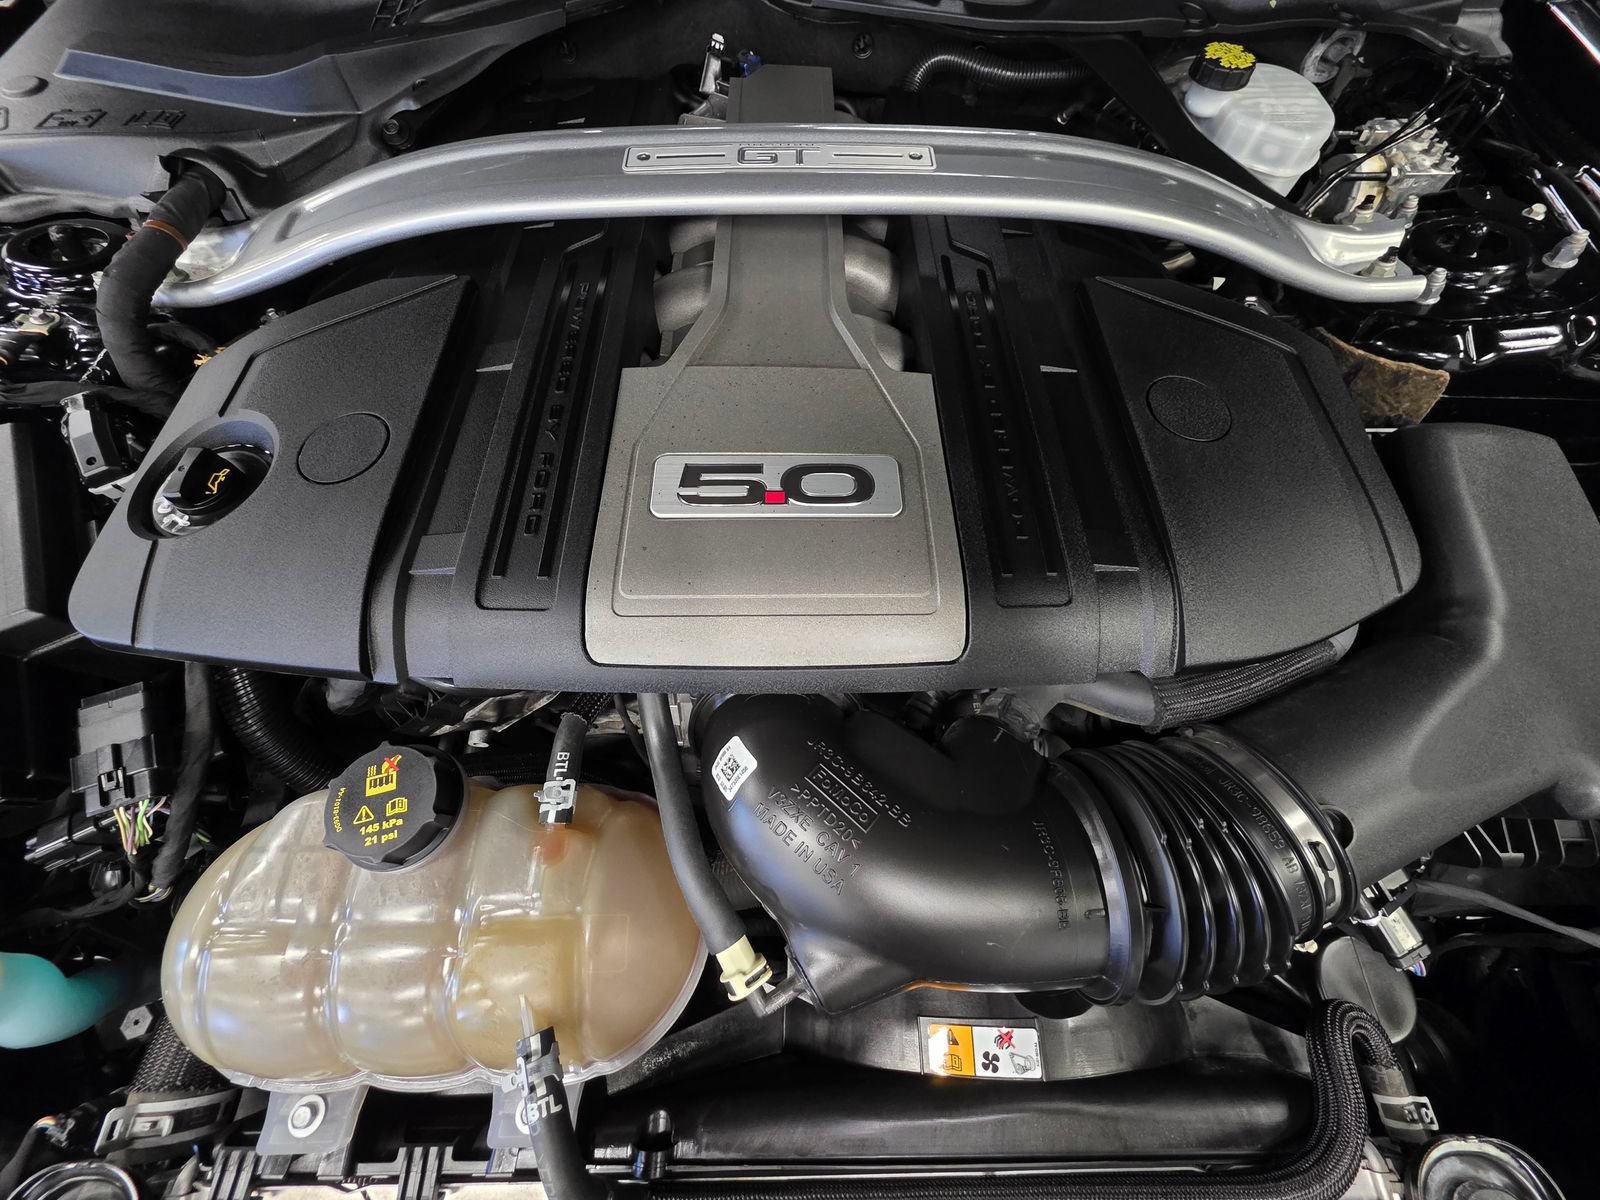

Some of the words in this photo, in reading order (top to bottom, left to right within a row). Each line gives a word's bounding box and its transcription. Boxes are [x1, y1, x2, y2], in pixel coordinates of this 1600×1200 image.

[737, 146, 820, 166] GT
[523, 452, 554, 537] FORD
[676, 462, 876, 507] 5.0
[812, 769, 869, 823] FoMoCo
[359, 822, 380, 835] 145
[382, 818, 404, 829] kPa
[364, 835, 378, 847] 21
[381, 829, 398, 844] psi
[752, 802, 797, 847] MADE
[794, 840, 814, 863] IN
[812, 857, 845, 896] USA
[815, 831, 850, 864] CAV
[527, 1094, 563, 1125] BTL
